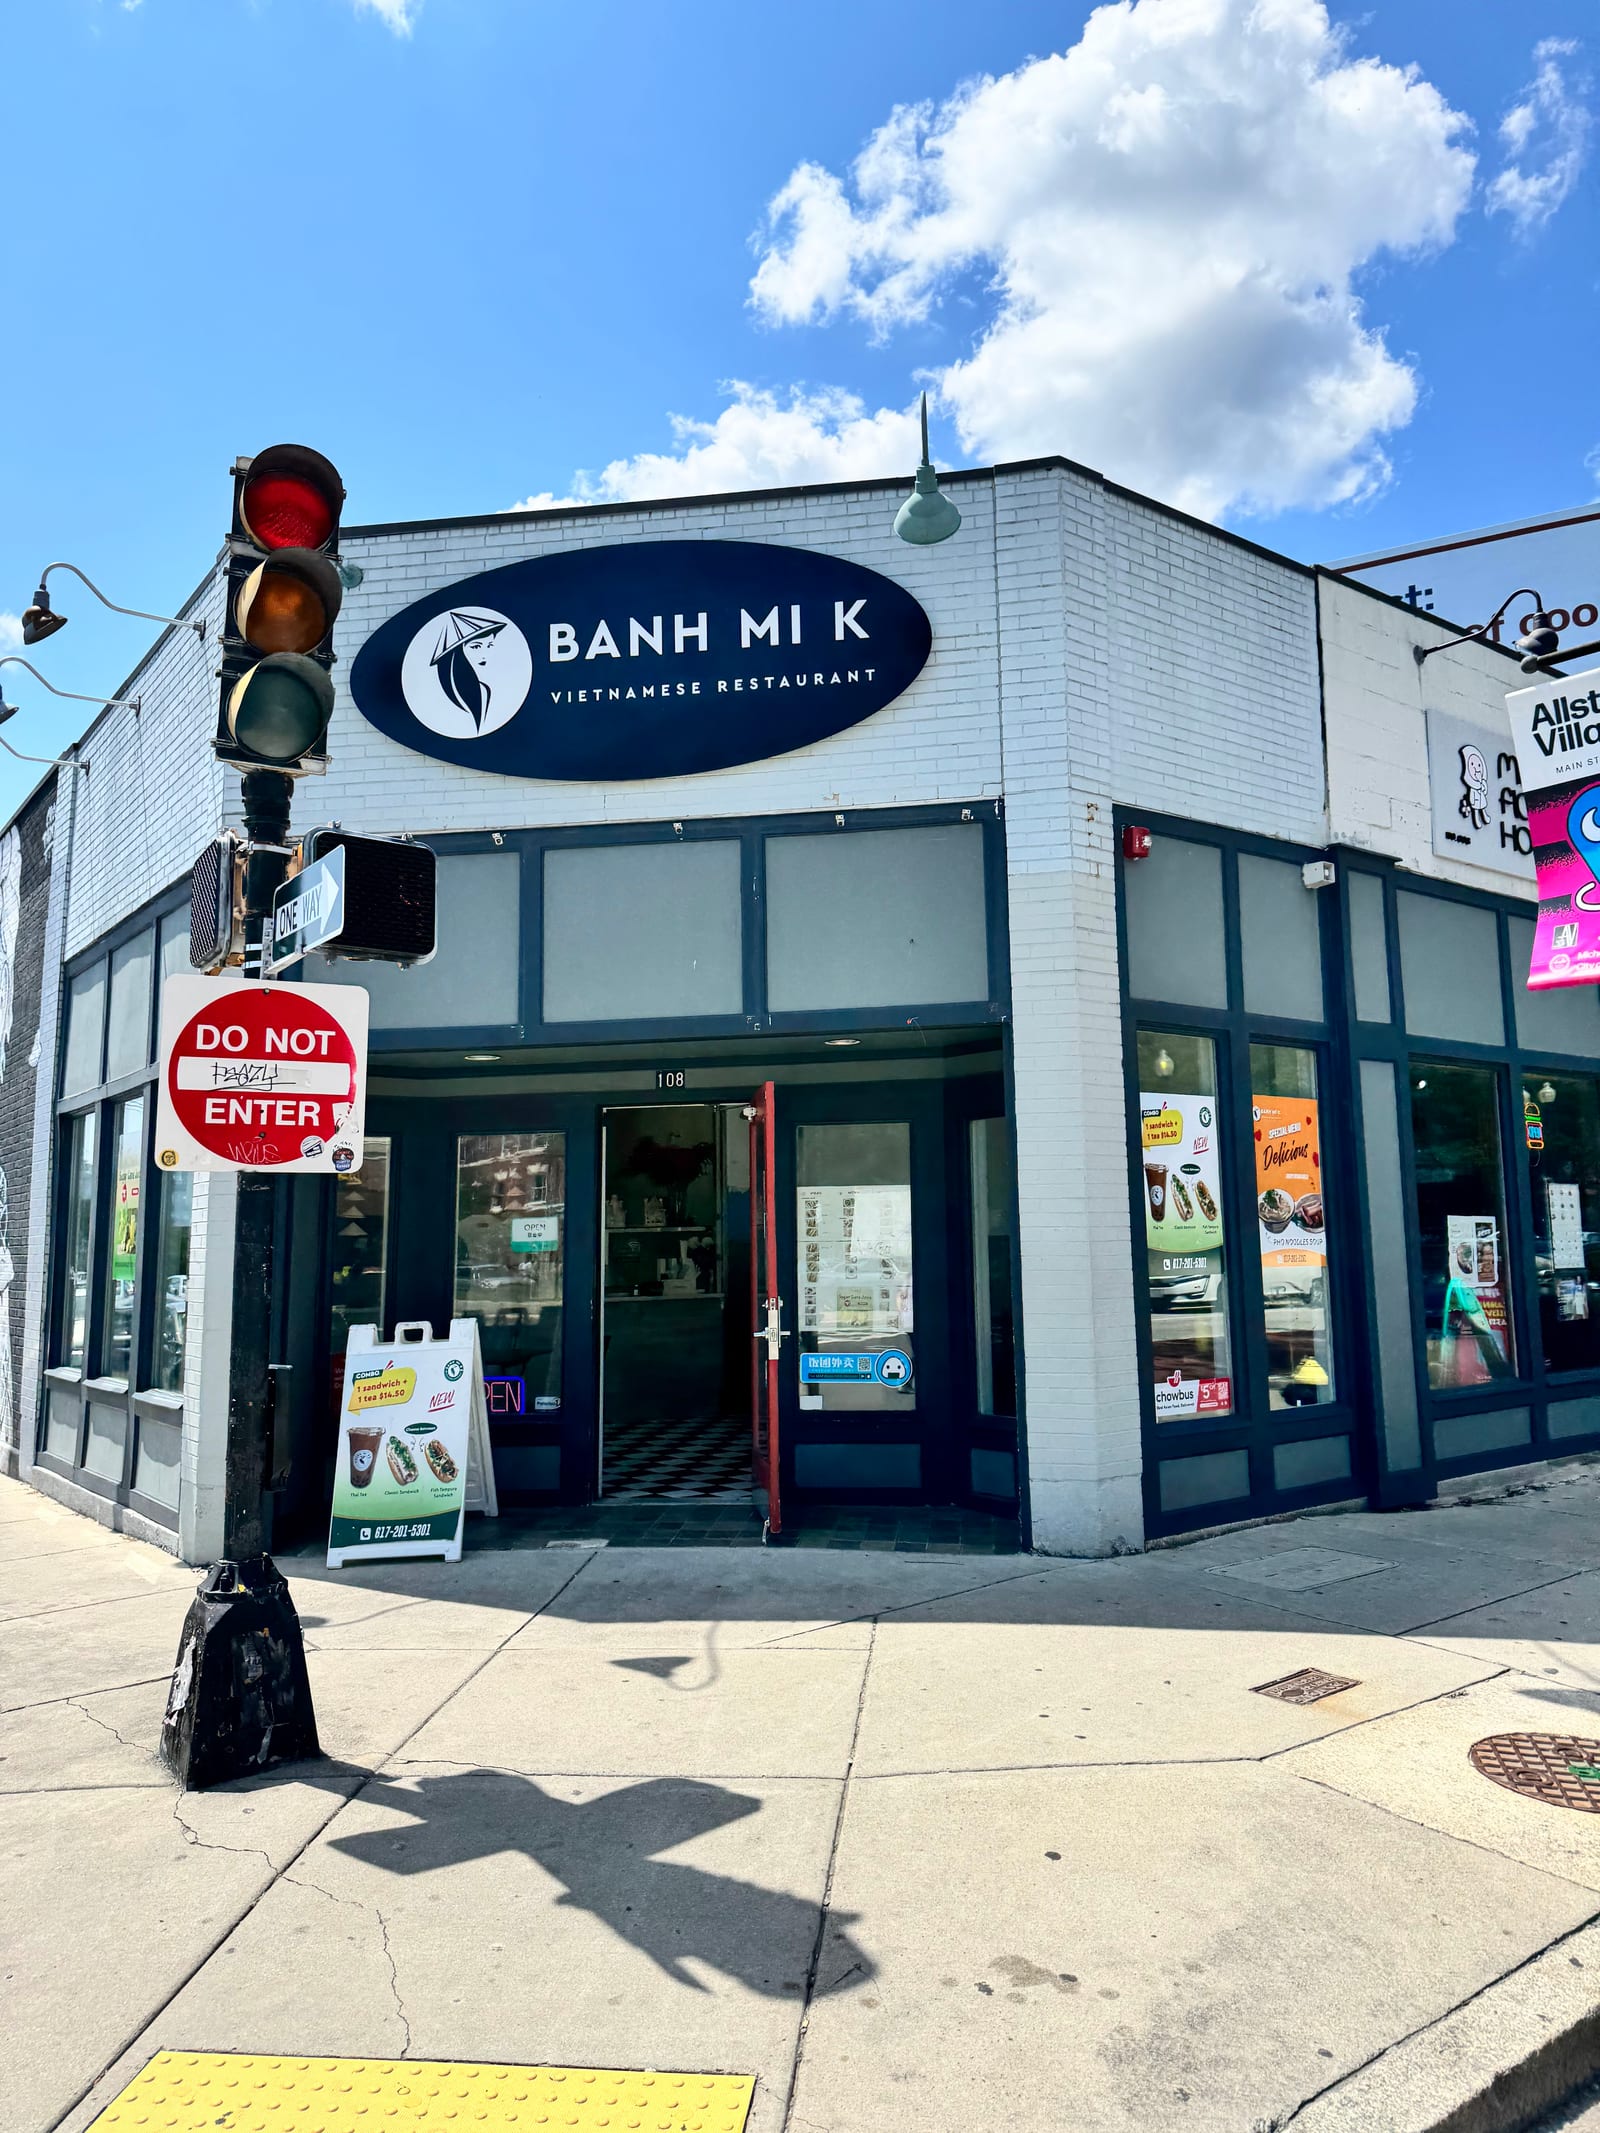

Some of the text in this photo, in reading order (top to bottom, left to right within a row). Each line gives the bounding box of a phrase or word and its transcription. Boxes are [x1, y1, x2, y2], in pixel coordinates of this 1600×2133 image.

[549, 599, 871, 662] BANH MI K
[551, 668, 877, 704] VIETNAMESE RESTAURANT
[1532, 690, 1600, 732] Allst
[1556, 761, 1583, 774] MAIN
[280, 885, 322, 937] ONE WAY
[196, 1024, 336, 1055] DO NOT
[658, 1072, 684, 1088] 108
[205, 1098, 321, 1127] ENTER
[1149, 1120, 1173, 1130] sandwich
[1151, 1132, 1160, 1140] tea
[1193, 1135, 1209, 1151] NEW
[1263, 1139, 1309, 1171] Delicious
[524, 1223, 546, 1231] OPEN
[355, 1370, 380, 1379] COMBO
[363, 1380, 401, 1392] sandwich
[364, 1394, 377, 1402] tea
[379, 1389, 405, 1401] $14.50
[430, 1389, 455, 1408] NEW
[484, 1381, 521, 1412] PEN
[1156, 1389, 1194, 1402] chowbus
[374, 1523, 431, 1539] 617-201-5301
